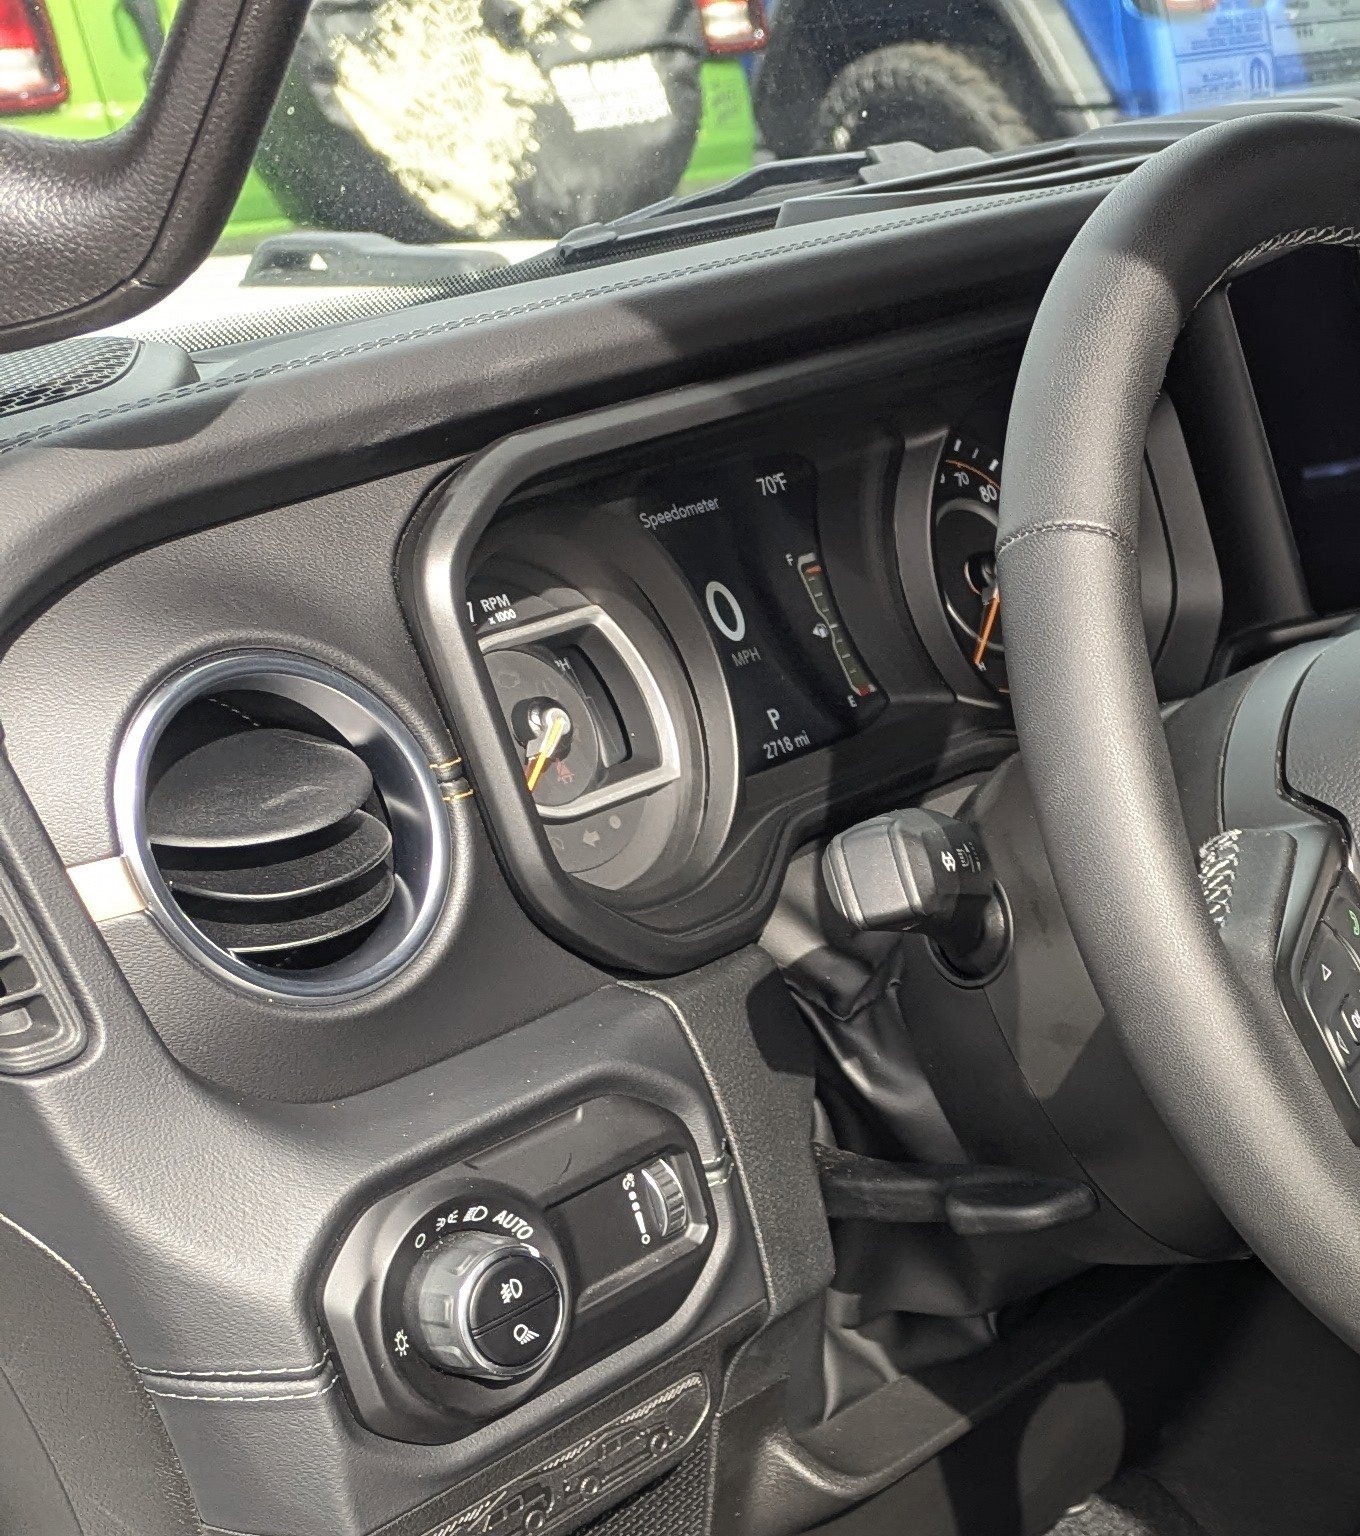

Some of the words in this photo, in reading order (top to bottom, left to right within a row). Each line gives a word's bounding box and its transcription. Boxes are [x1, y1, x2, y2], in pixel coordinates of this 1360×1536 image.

[979, 484, 997, 503] 80
[639, 497, 720, 530] Speedometer
[480, 594, 511, 613] RPM
[705, 581, 746, 642] 0
[731, 647, 762, 668] MPH
[766, 708, 781, 730] P
[762, 736, 794, 760] 2718
[795, 730, 811, 748] mi
[492, 1209, 534, 1240] AUTO
